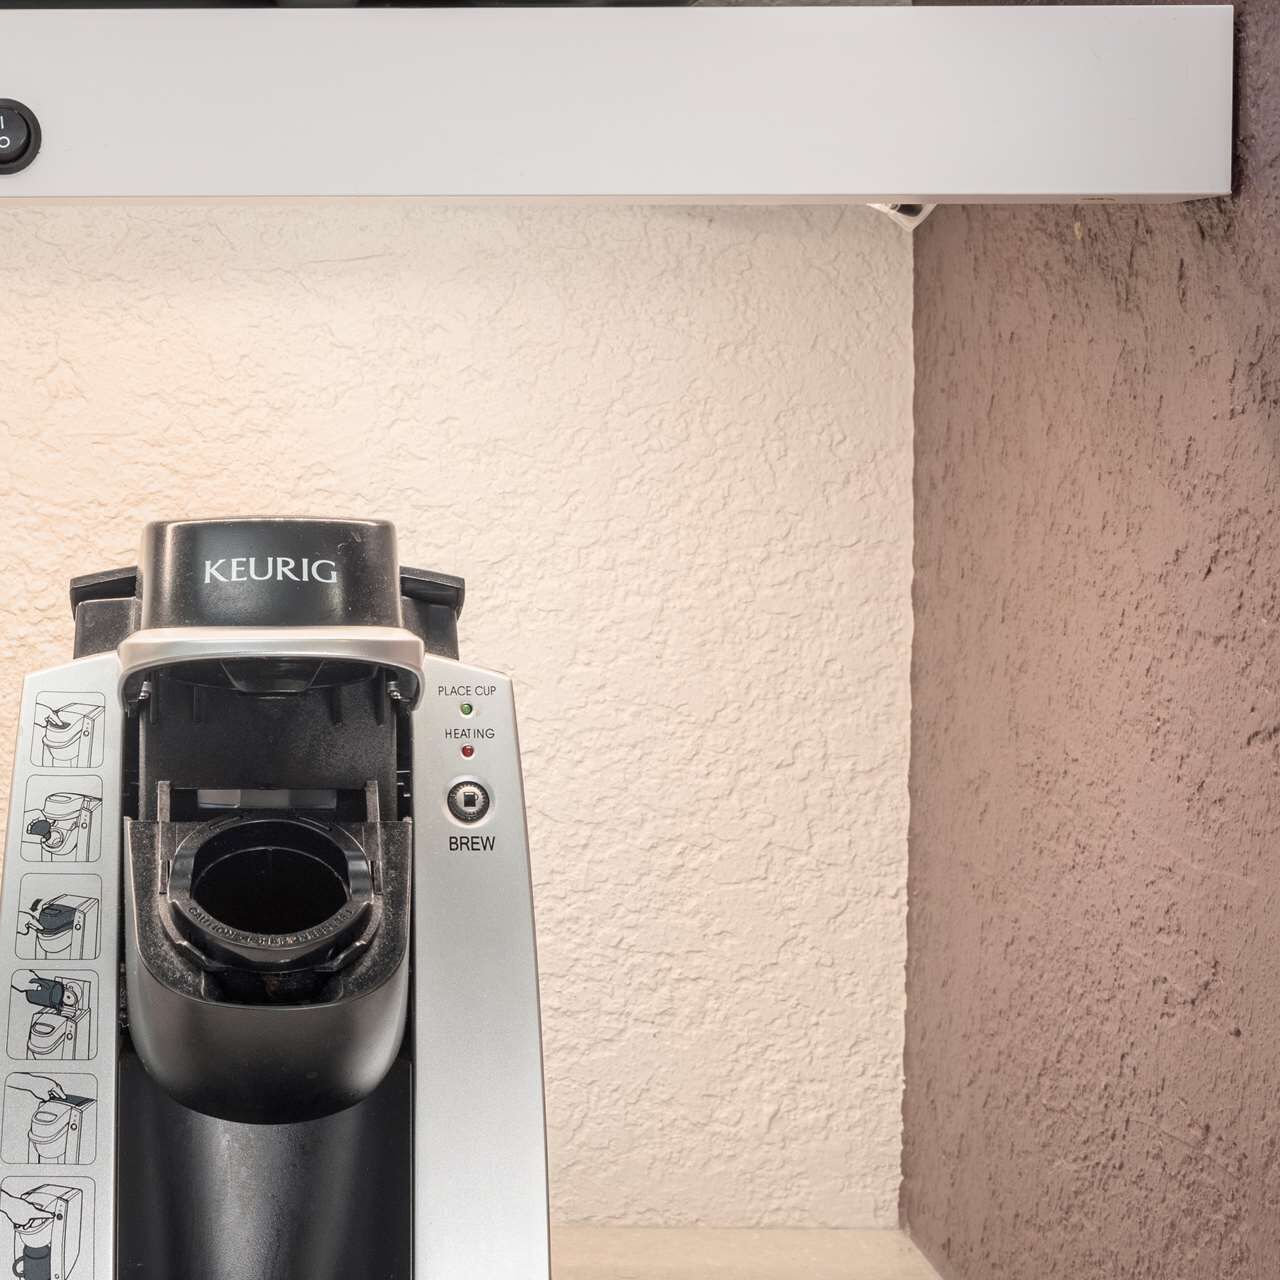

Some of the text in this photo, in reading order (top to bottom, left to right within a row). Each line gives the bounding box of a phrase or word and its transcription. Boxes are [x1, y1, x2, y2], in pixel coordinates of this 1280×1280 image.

[204, 557, 338, 584] KEURIG
[438, 685, 497, 696] PLACE CUP
[445, 728, 495, 739] HEATING
[449, 836, 496, 852] BREW
